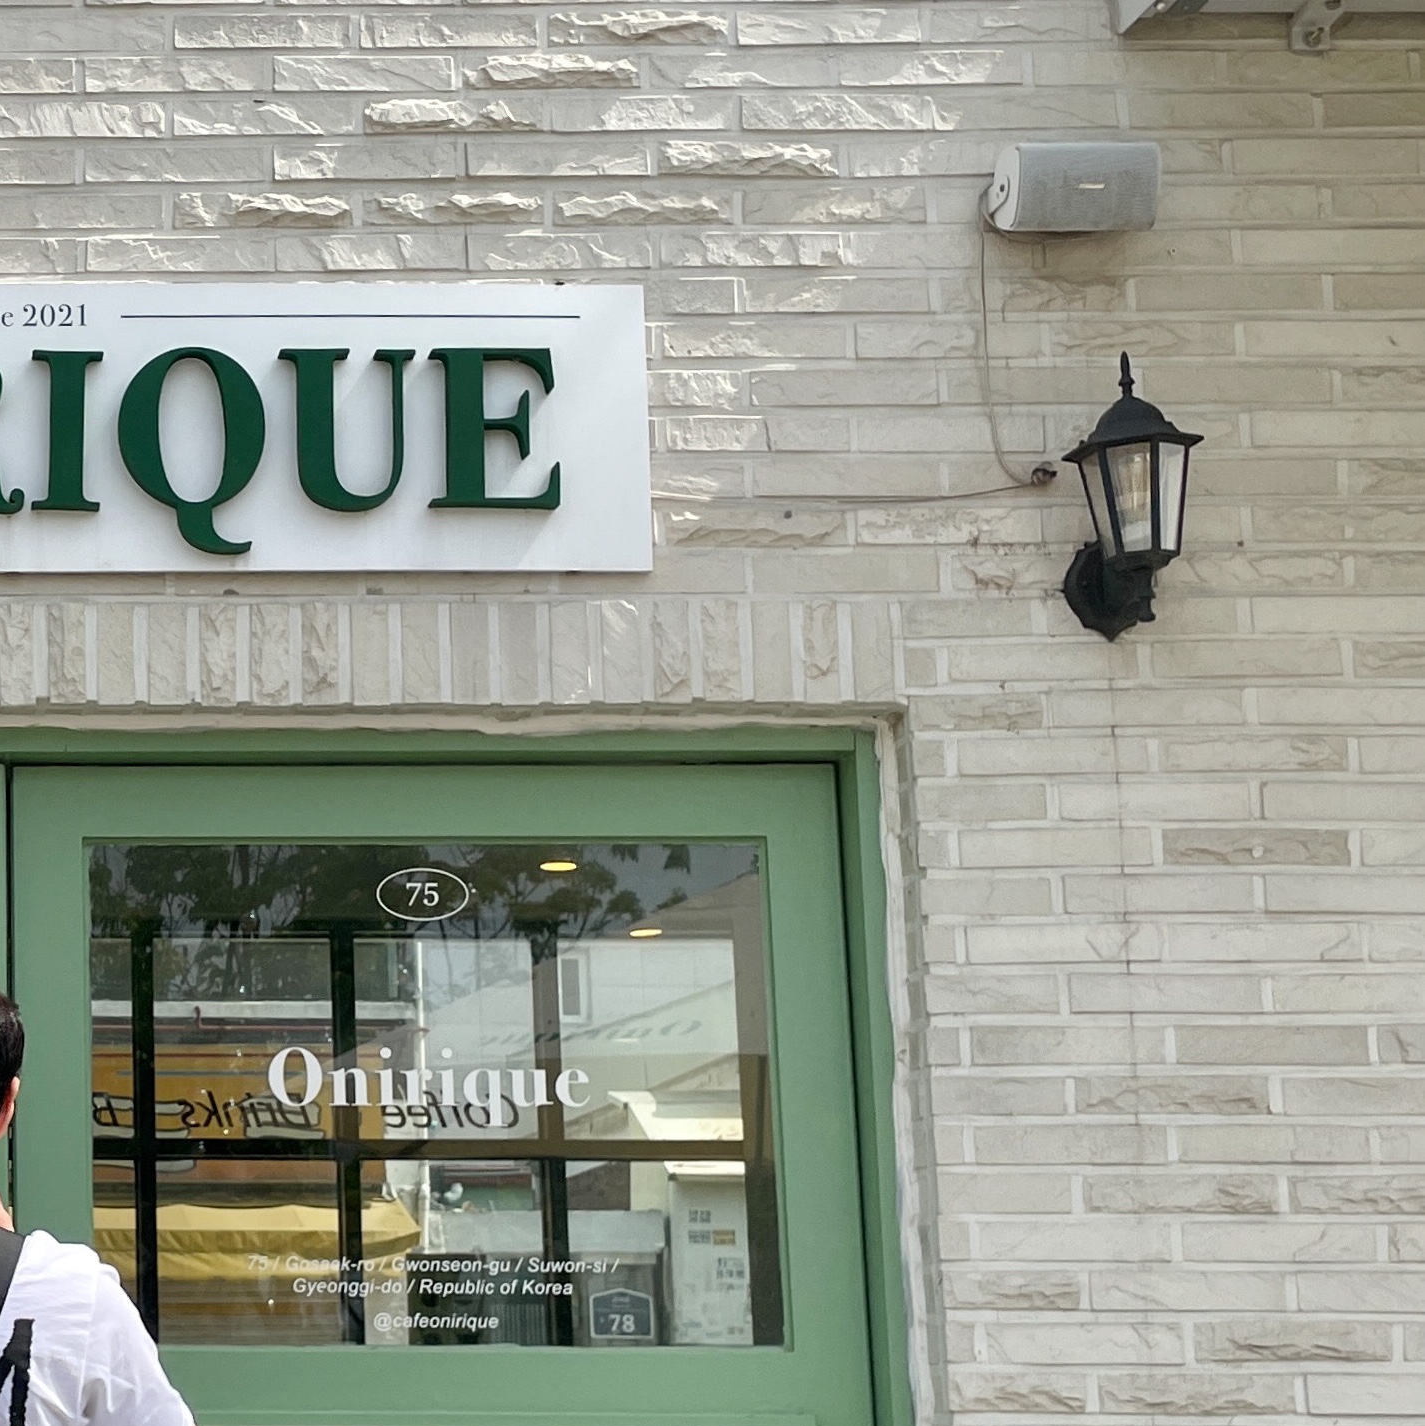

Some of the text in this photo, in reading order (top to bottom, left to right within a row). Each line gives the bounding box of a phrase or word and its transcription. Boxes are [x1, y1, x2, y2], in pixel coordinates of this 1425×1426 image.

[21, 304, 88, 331] 2021
[405, 880, 440, 907] 75
[267, 1045, 591, 1129] Onirique
[285, 1256, 374, 1273] Gosaek-ro
[391, 1256, 511, 1276] Gwonseon-gu
[527, 1257, 607, 1273] Suwon-si
[292, 1278, 403, 1298] Gyeonggi-do
[418, 1278, 495, 1296] Republic
[500, 1278, 519, 1295] of
[521, 1278, 574, 1296] Korea
[373, 1313, 499, 1332] @cafeonirique
[608, 1313, 635, 1333] 78
